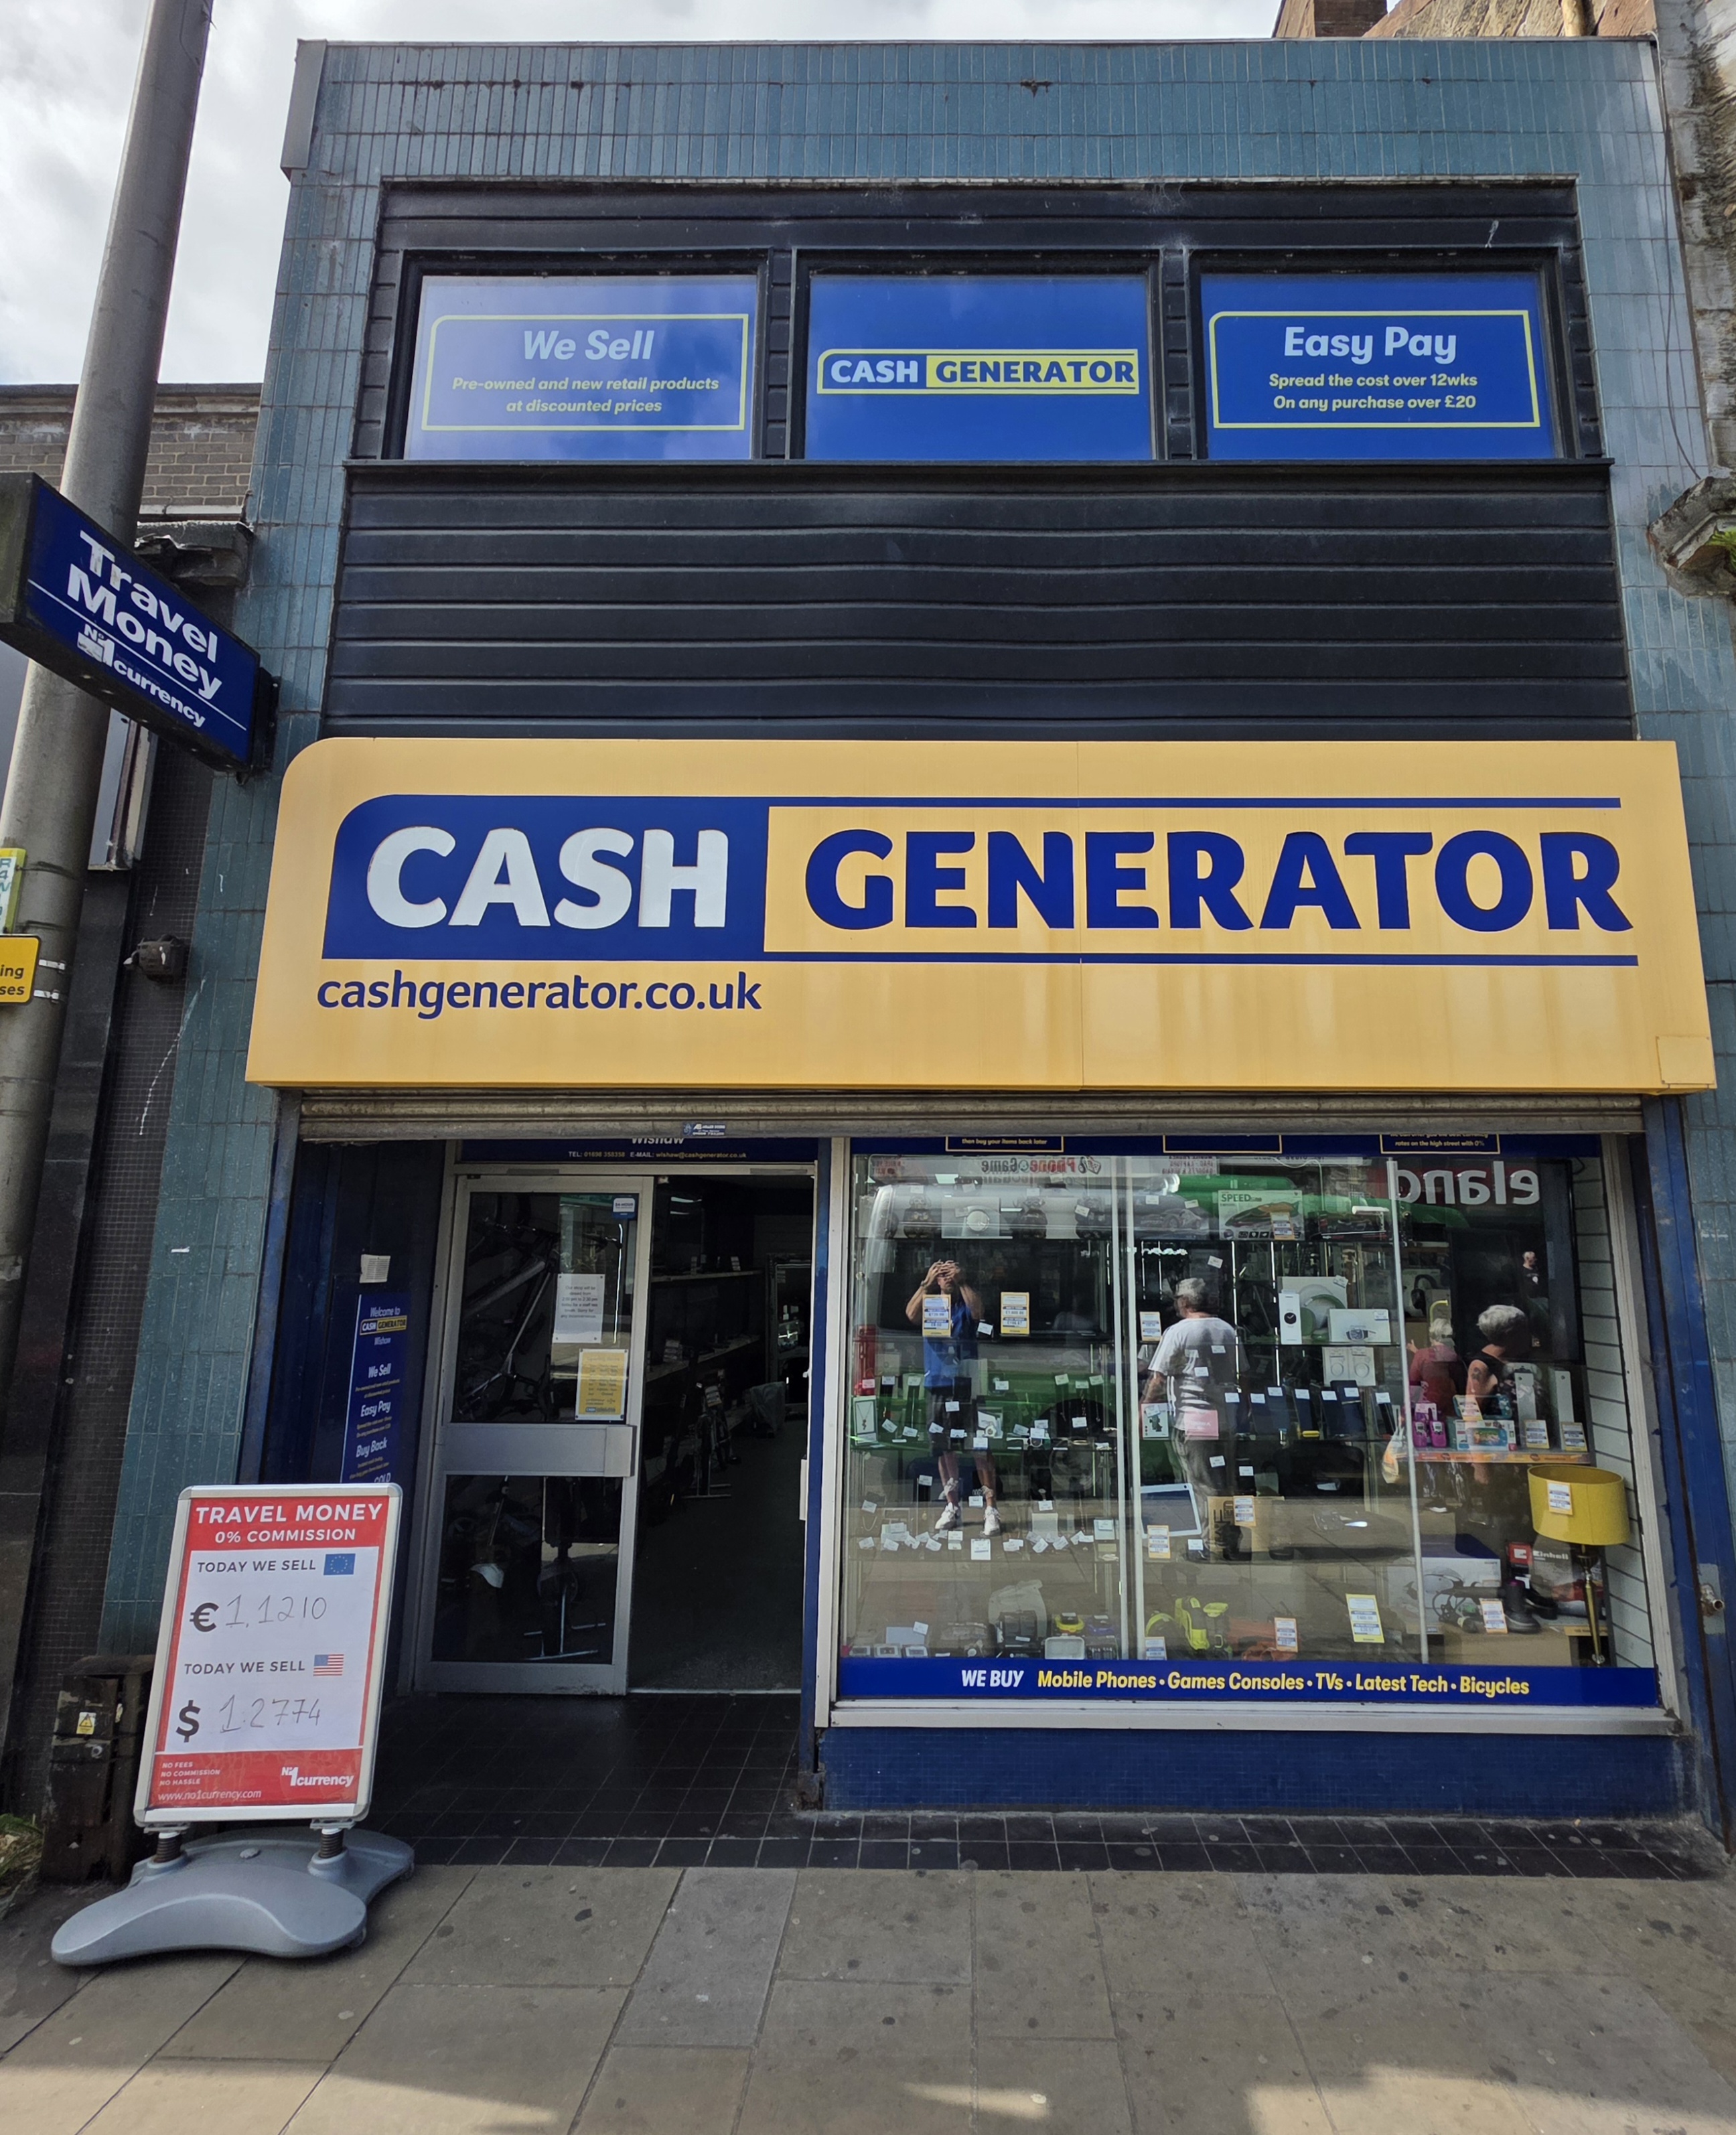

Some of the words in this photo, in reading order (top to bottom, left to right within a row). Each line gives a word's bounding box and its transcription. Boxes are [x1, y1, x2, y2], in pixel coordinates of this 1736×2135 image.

[523, 330, 576, 360] We
[585, 329, 654, 360] Sell
[1284, 326, 1373, 365] Easy
[1384, 326, 1457, 365] Pay
[830, 360, 918, 384] CASH
[936, 360, 1135, 384] GENERATOR
[452, 377, 535, 391] Pre-owned
[538, 378, 569, 391] and
[572, 380, 602, 391] new
[606, 377, 648, 391] retail
[650, 377, 720, 393] products
[1269, 374, 1325, 388] Spread
[1328, 374, 1352, 387] the
[1356, 375, 1390, 387] cost
[1393, 376, 1427, 387] over
[1430, 374, 1477, 387] 12wks
[506, 400, 523, 413] at
[526, 398, 611, 413] discounted
[614, 400, 662, 415] prices
[1273, 395, 1295, 409] On
[1299, 397, 1328, 412] any
[1332, 395, 1404, 412] purchase
[1407, 398, 1441, 409] over
[1444, 395, 1476, 409] £20
[80, 530, 218, 663] Travel
[67, 563, 222, 701] Money
[113, 659, 206, 728] currency
[367, 826, 729, 930] CASH
[804, 828, 1634, 932] GENERATOR
[317, 969, 762, 1019] cashgenerator.co.uk
[1221, 1193, 1252, 1202] SPEED
[370, 1306, 394, 1317] Welcome
[394, 1306, 401, 1316] to
[362, 1322, 376, 1331] CASH
[378, 1319, 407, 1329] GENERATOR
[368, 1366, 378, 1378] We
[378, 1363, 392, 1376] Sell
[360, 1404, 377, 1418] Easy
[378, 1400, 391, 1414] Pay
[356, 1445, 370, 1458] Buy
[370, 1437, 388, 1453] Back
[196, 1505, 287, 1524] TRAVEL
[295, 1503, 383, 1522] MONEY
[214, 1531, 241, 1544] 0%
[247, 1528, 356, 1543] COMMISSION
[197, 1561, 248, 1573] TODAY
[252, 1560, 277, 1572] WE
[281, 1559, 316, 1572] SELL
[184, 1662, 235, 1675] TODAY
[240, 1661, 265, 1674] WE
[269, 1660, 305, 1672] SELL
[961, 1670, 986, 1687] WE
[990, 1670, 1025, 1687] BUY
[1037, 1670, 1092, 1688] Mobile
[1096, 1671, 1156, 1689] Phones
[1167, 1671, 1225, 1690] Games
[1228, 1672, 1305, 1690] Consoles
[1315, 1673, 1344, 1690] TVs
[1355, 1674, 1406, 1692] Latest
[1410, 1674, 1448, 1693] Tech
[1460, 1676, 1530, 1698] Bicycles
[297, 1774, 354, 1787] currency
[157, 1789, 262, 1801] www.no1currency.com
